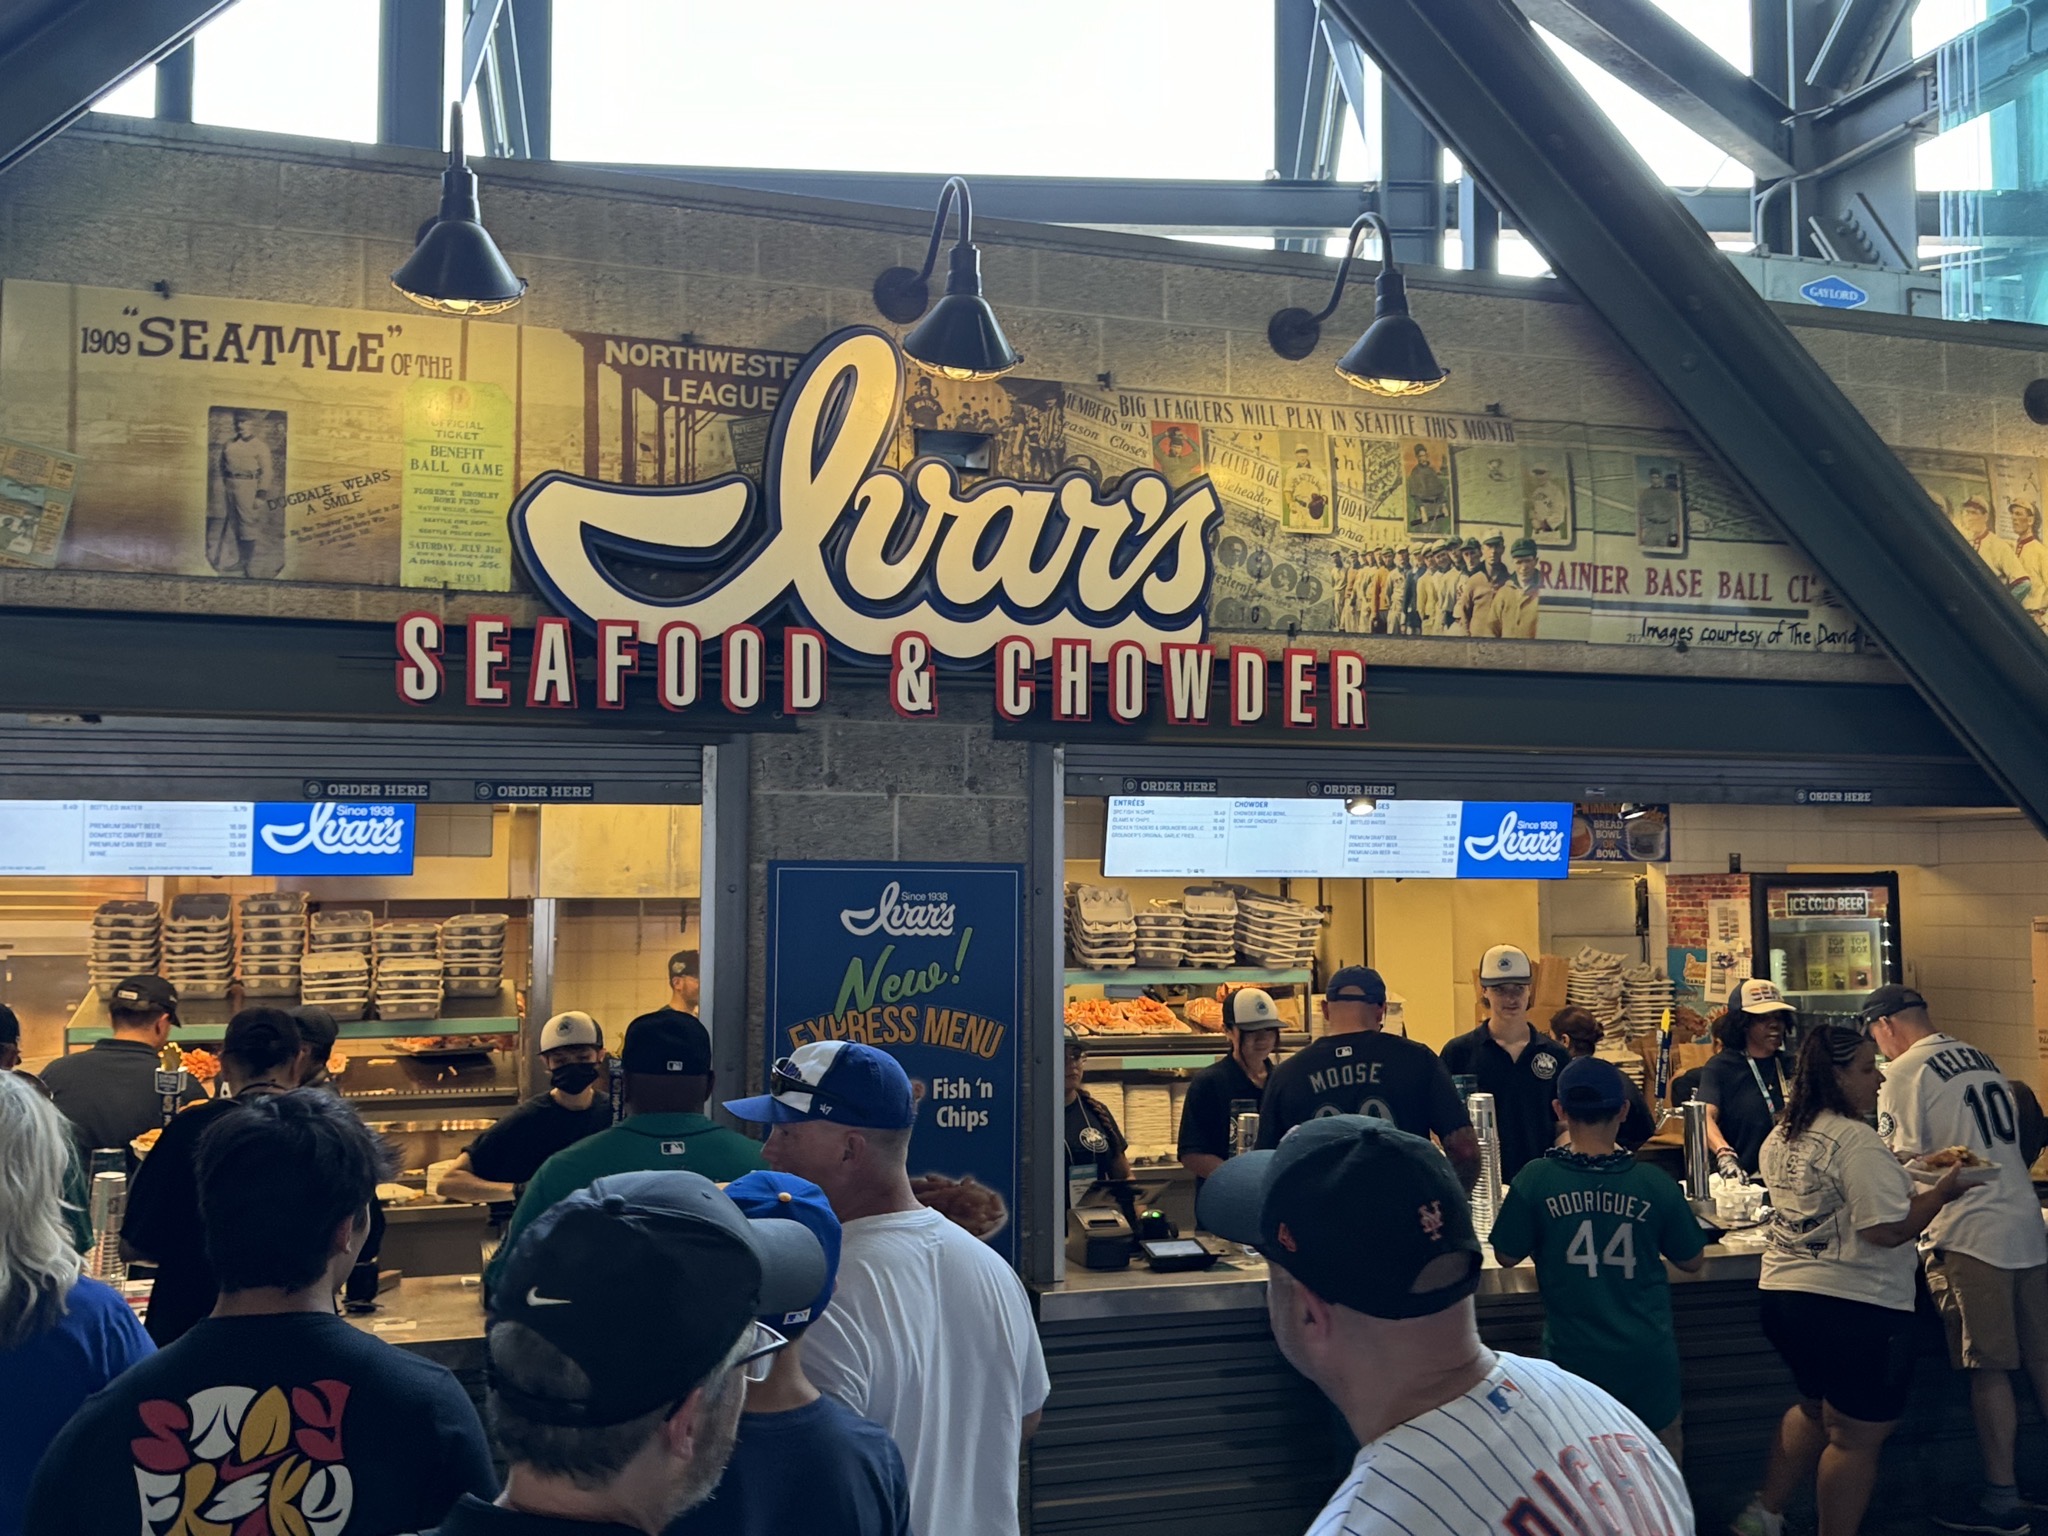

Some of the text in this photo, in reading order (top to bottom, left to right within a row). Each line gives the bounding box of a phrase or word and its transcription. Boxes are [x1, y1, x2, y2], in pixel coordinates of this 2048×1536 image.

[1809, 286, 1859, 301] GAYLORD
[81, 326, 130, 356] 1909
[391, 352, 412, 377] OF
[414, 353, 452, 380] THE
[604, 340, 799, 380] NORTHWESTE
[663, 377, 780, 411] LEAGUE
[430, 419, 484, 431] OFFICIAL
[1119, 395, 1147, 418] BIG
[1241, 403, 1279, 427] WILL
[1286, 406, 1323, 431] PLAY
[1330, 409, 1347, 431] IN
[1354, 410, 1416, 437] SEATTLE
[1423, 415, 1458, 440] THIS
[1463, 419, 1515, 443] MONTH
[435, 430, 479, 441] TICKET
[1062, 420, 1148, 459] eason Closes
[430, 445, 484, 460] BENEFIT
[410, 459, 504, 476] BALL GAME
[1220, 450, 1265, 482] CLUB TO
[266, 470, 391, 511] DUGDALE WEARS
[413, 487, 455, 497] FLORENCE
[306, 491, 363, 516] A SMILE
[459, 543, 480, 553] JULY
[408, 556, 474, 568] ADMISSION
[1539, 560, 1816, 603] RAINIER BASE BALL CL
[1641, 617, 1694, 647] Images
[1701, 621, 1763, 646] courtesy
[1767, 619, 1785, 644] of
[1788, 622, 1811, 645] The
[1816, 623, 1862, 646] David
[396, 611, 1369, 730] SEAFOOD & CHOWDER
[327, 784, 428, 797] ORDER HERE
[497, 785, 592, 798] ORDER HERE
[1140, 781, 1216, 793] ORDER HERE
[1323, 784, 1396, 796] ORDER HERE
[1113, 798, 1145, 806] ENTRÉES
[1809, 791, 1871, 802] ORDER HERE
[336, 805, 395, 816] Since 1938
[1517, 820, 1558, 830] Since 1938
[1593, 820, 1624, 830] BREAD
[1464, 811, 1564, 861] Ivar's
[1595, 829, 1622, 839] BOWL
[1602, 840, 1615, 848] OR
[1596, 849, 1623, 859] BOWL
[901, 891, 948, 901] Since 1938
[1789, 896, 1864, 911] ICE COLD BEER
[840, 881, 955, 936] Ivar's
[1851, 937, 1867, 946] TOP
[1851, 946, 1867, 954] BOX
[787, 1004, 1006, 1060] EXPRESS MENU
[1309, 1063, 1383, 1094] MOOSE
[932, 1077, 971, 1100] Fish
[936, 1106, 989, 1132] Chips
[1963, 1081, 2016, 1149] 10
[1546, 1184, 1652, 1223] RODRÍGUEZ
[1566, 1219, 1637, 1280] 44
